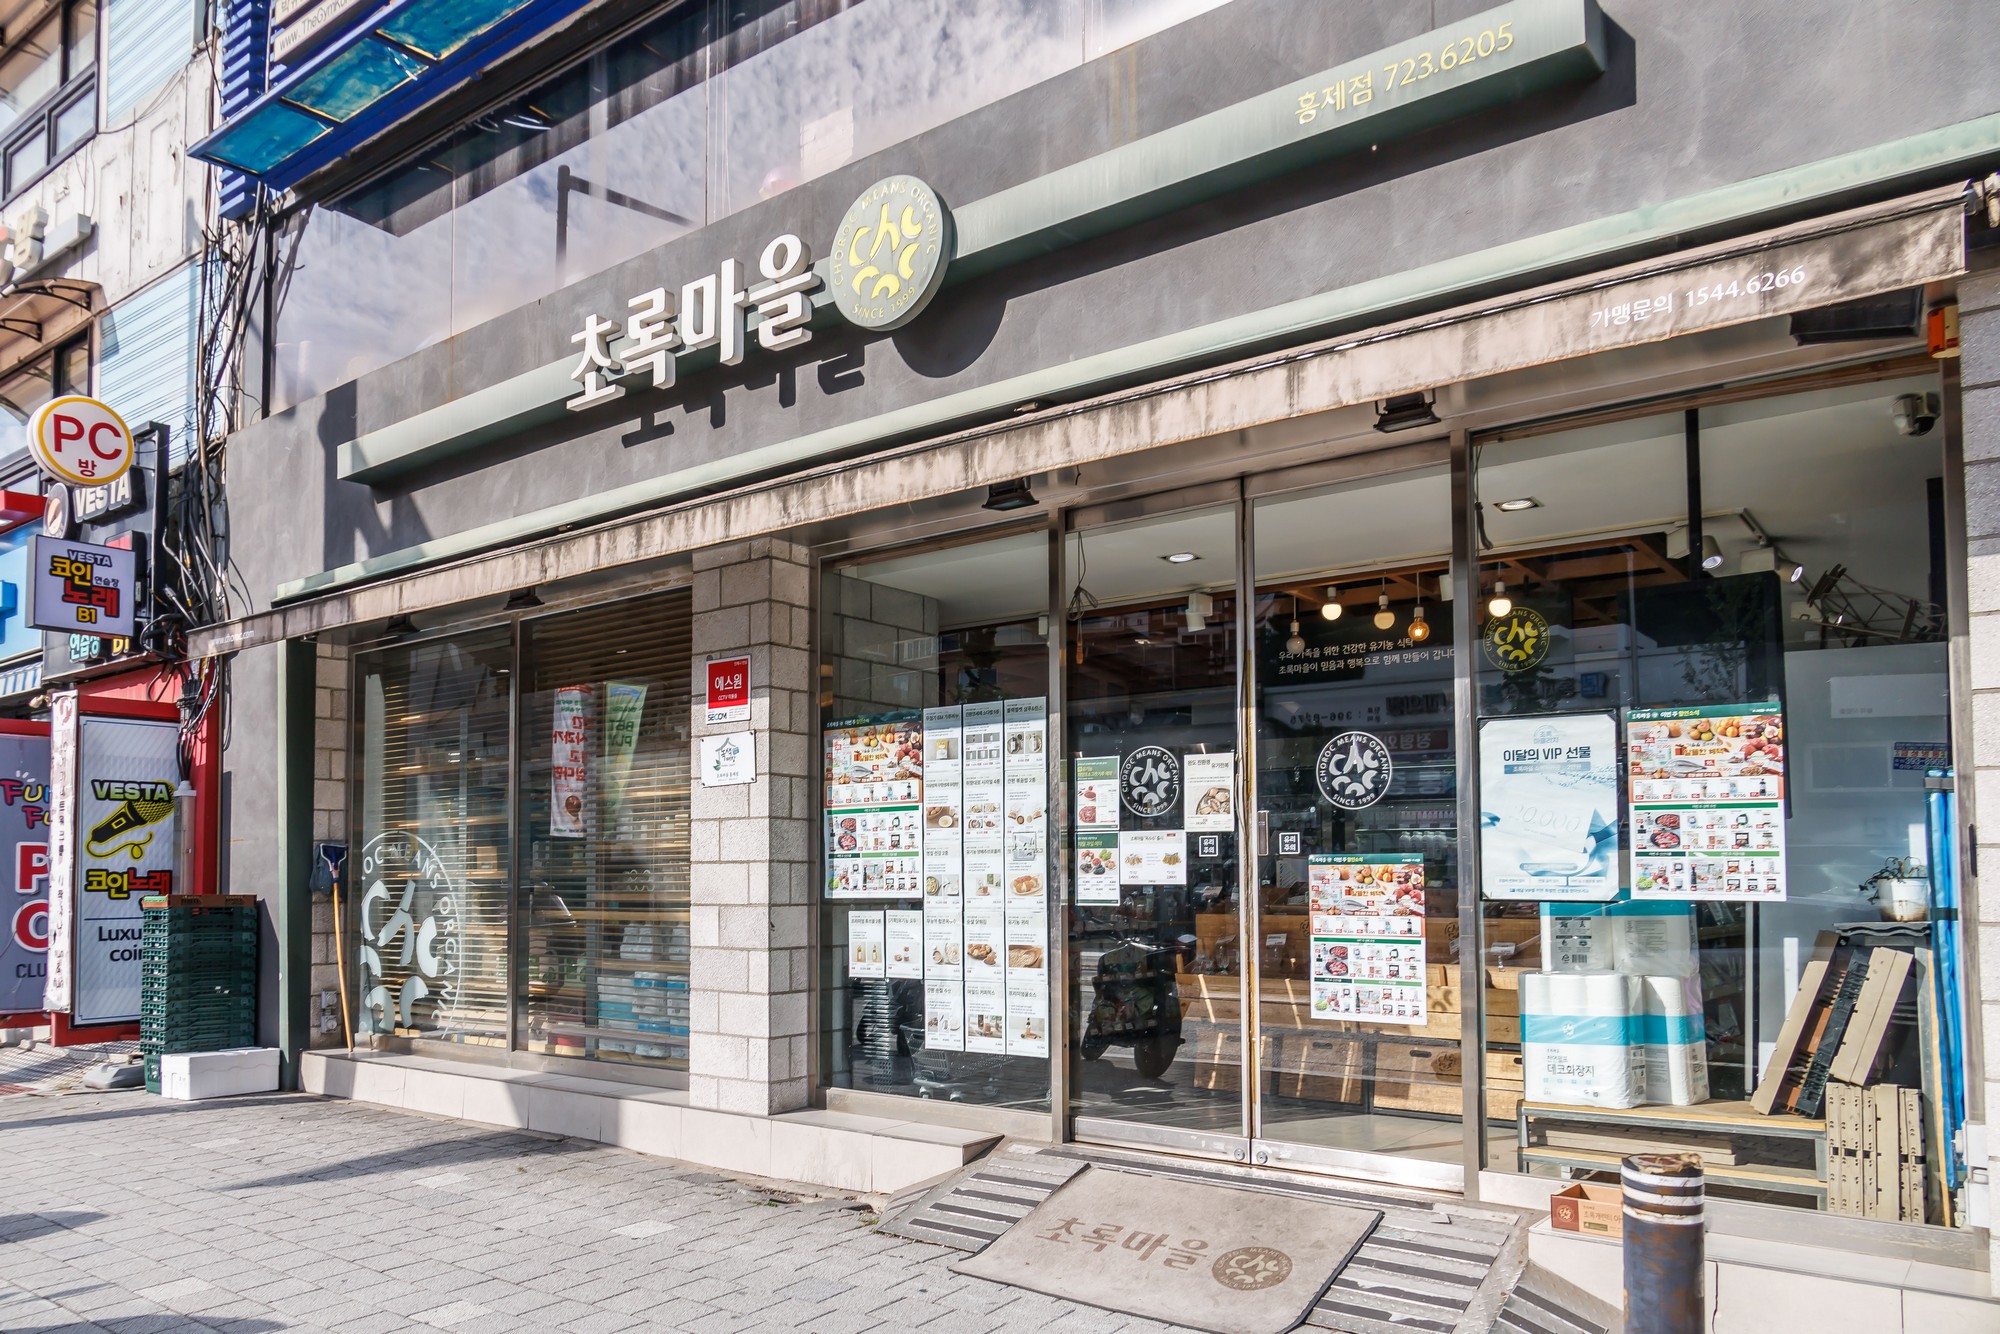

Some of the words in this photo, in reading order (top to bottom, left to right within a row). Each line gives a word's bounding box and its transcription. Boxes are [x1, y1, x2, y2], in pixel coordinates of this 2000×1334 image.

[1294, 69, 1374, 125] 홍제점
[1383, 21, 1514, 92] 723.6205
[834, 211, 857, 286] CHOROC
[861, 180, 906, 211] MEANS
[910, 185, 938, 255] ORGANIC
[852, 303, 884, 320] SINCE
[890, 286, 916, 313] 1999
[1591, 293, 1673, 328] 가맹문의
[1686, 265, 1806, 308] 1544.6266
[566, 233, 820, 412] 초록마을
[53, 413, 122, 461] PC
[78, 458, 97, 477] 방
[74, 471, 130, 519] VESTA
[51, 556, 92, 586] 코인
[94, 576, 119, 587] 연습장
[67, 549, 113, 567] VESTA
[62, 580, 119, 617] 노래
[77, 606, 97, 624] B1
[1507, 610, 1528, 618] EANS
[1323, 645, 1340, 656] 위한
[1342, 643, 1367, 655] 건강한
[1369, 640, 1394, 651] 유기농
[1278, 663, 1318, 675] 초록마을이
[1320, 659, 1344, 672] 믿음과
[1347, 656, 1380, 668] 행복으로
[1383, 653, 1400, 665] 함께
[1402, 650, 1429, 663] 만들어
[715, 673, 742, 691] 에스원
[707, 712, 728, 721] SECOM
[1319, 744, 1336, 783] CHOROC
[1337, 734, 1367, 746] MEANS
[1369, 741, 1388, 780] ORGANIC
[1503, 748, 1539, 761] 이달의
[1543, 747, 1562, 760] VIP
[1566, 746, 1591, 759] 선물
[1121, 757, 1135, 793] CHOROC
[1136, 750, 1161, 760] MEANS
[1162, 755, 1179, 790] ORGANIC
[92, 780, 170, 801] VESTA
[1333, 794, 1355, 806] SINCE
[1358, 793, 1375, 805] 1999
[1132, 802, 1150, 814] SINCE
[1153, 802, 1168, 813] 1999
[85, 867, 173, 900] 코인노래
[1547, 1064, 1594, 1077] 데코화장지
[1035, 1217, 1209, 1271] 초록마을
